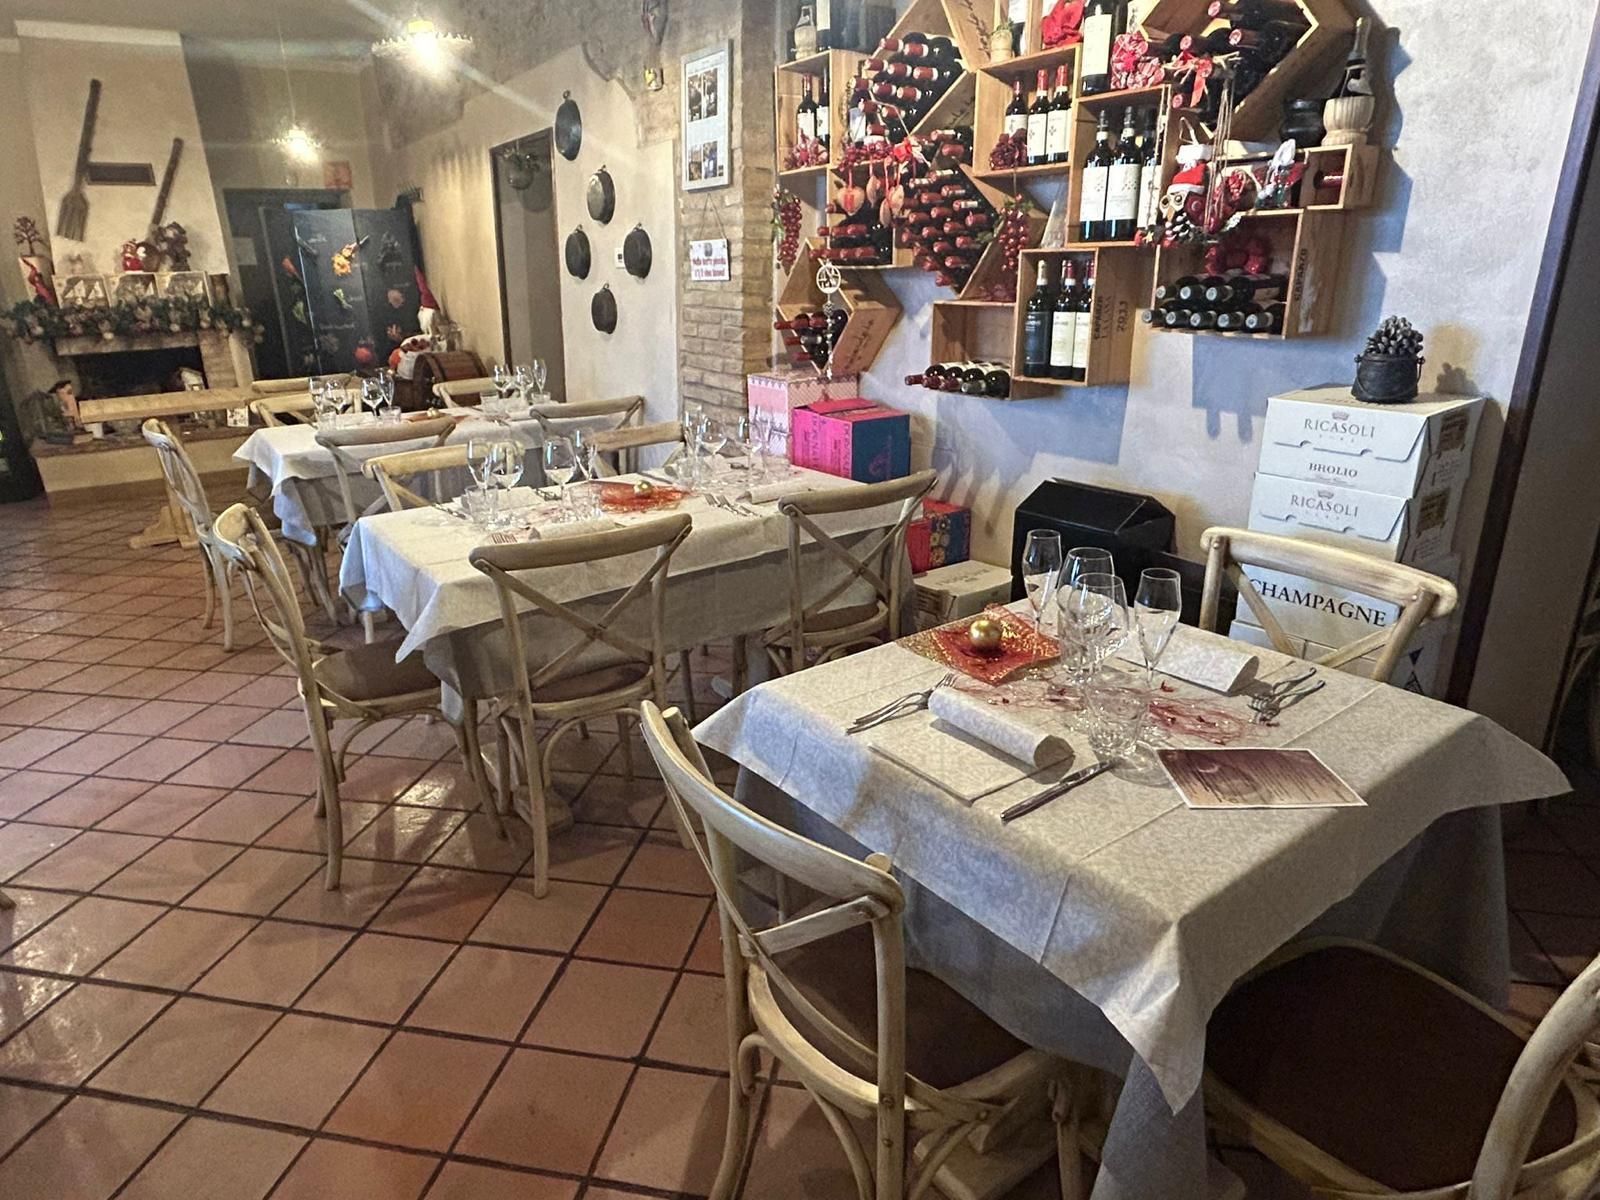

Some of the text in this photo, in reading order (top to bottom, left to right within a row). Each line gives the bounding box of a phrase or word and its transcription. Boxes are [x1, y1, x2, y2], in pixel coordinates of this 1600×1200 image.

[1304, 418, 1375, 438] RICASOLI
[1308, 462, 1358, 478] BROLIO
[1290, 494, 1359, 517] RICASOLI
[1249, 578, 1388, 628] CHAMPAGNE
